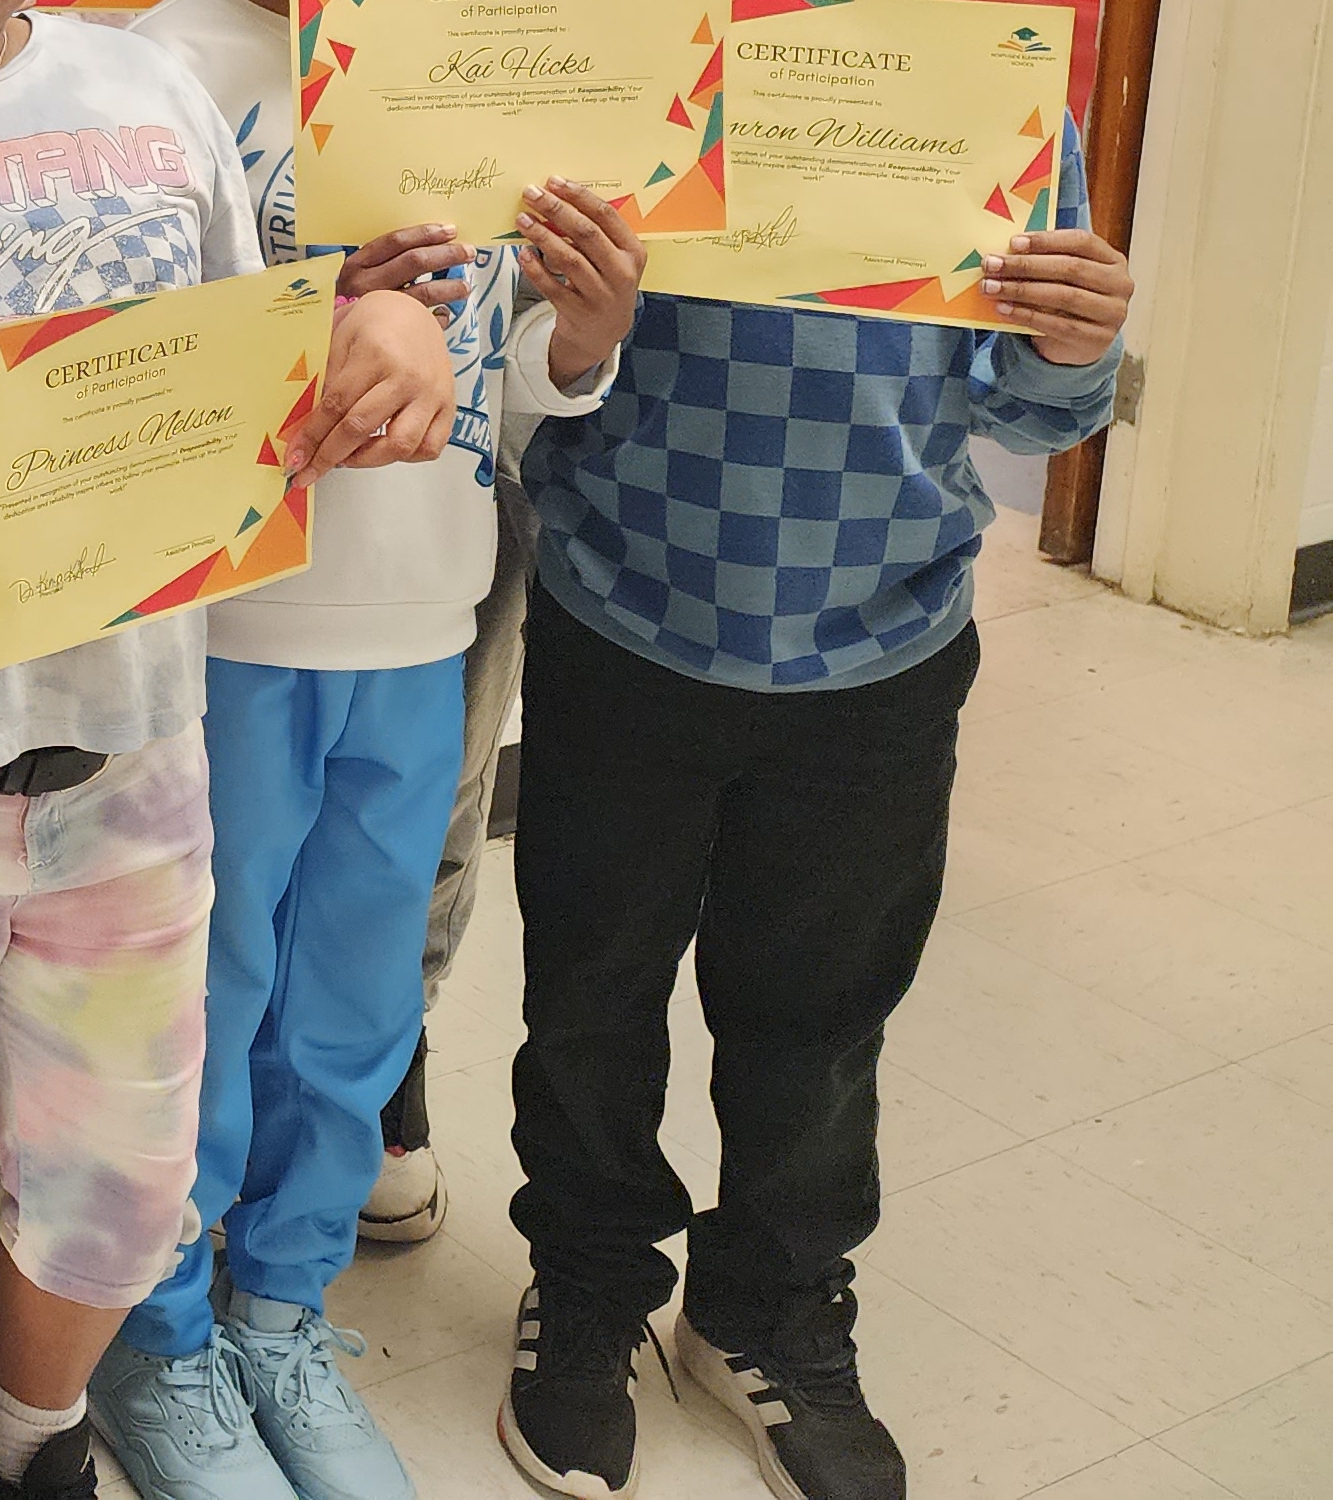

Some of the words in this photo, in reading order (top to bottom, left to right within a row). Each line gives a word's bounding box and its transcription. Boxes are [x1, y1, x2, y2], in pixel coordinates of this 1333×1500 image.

[460, 6, 474, 18] of
[478, 4, 557, 17] Participation
[429, 47, 495, 83] Kai
[501, 44, 595, 79] Hicks
[736, 43, 911, 72] CERTIFICATE
[769, 68, 784, 79] of
[788, 69, 875, 87] Participation
[806, 118, 969, 155] Williams
[45, 333, 199, 389] CERTIFICATE
[76, 385, 89, 400] of
[92, 367, 166, 395] Participation
[6, 431, 133, 491] Princess
[138, 405, 233, 445] Nelson
